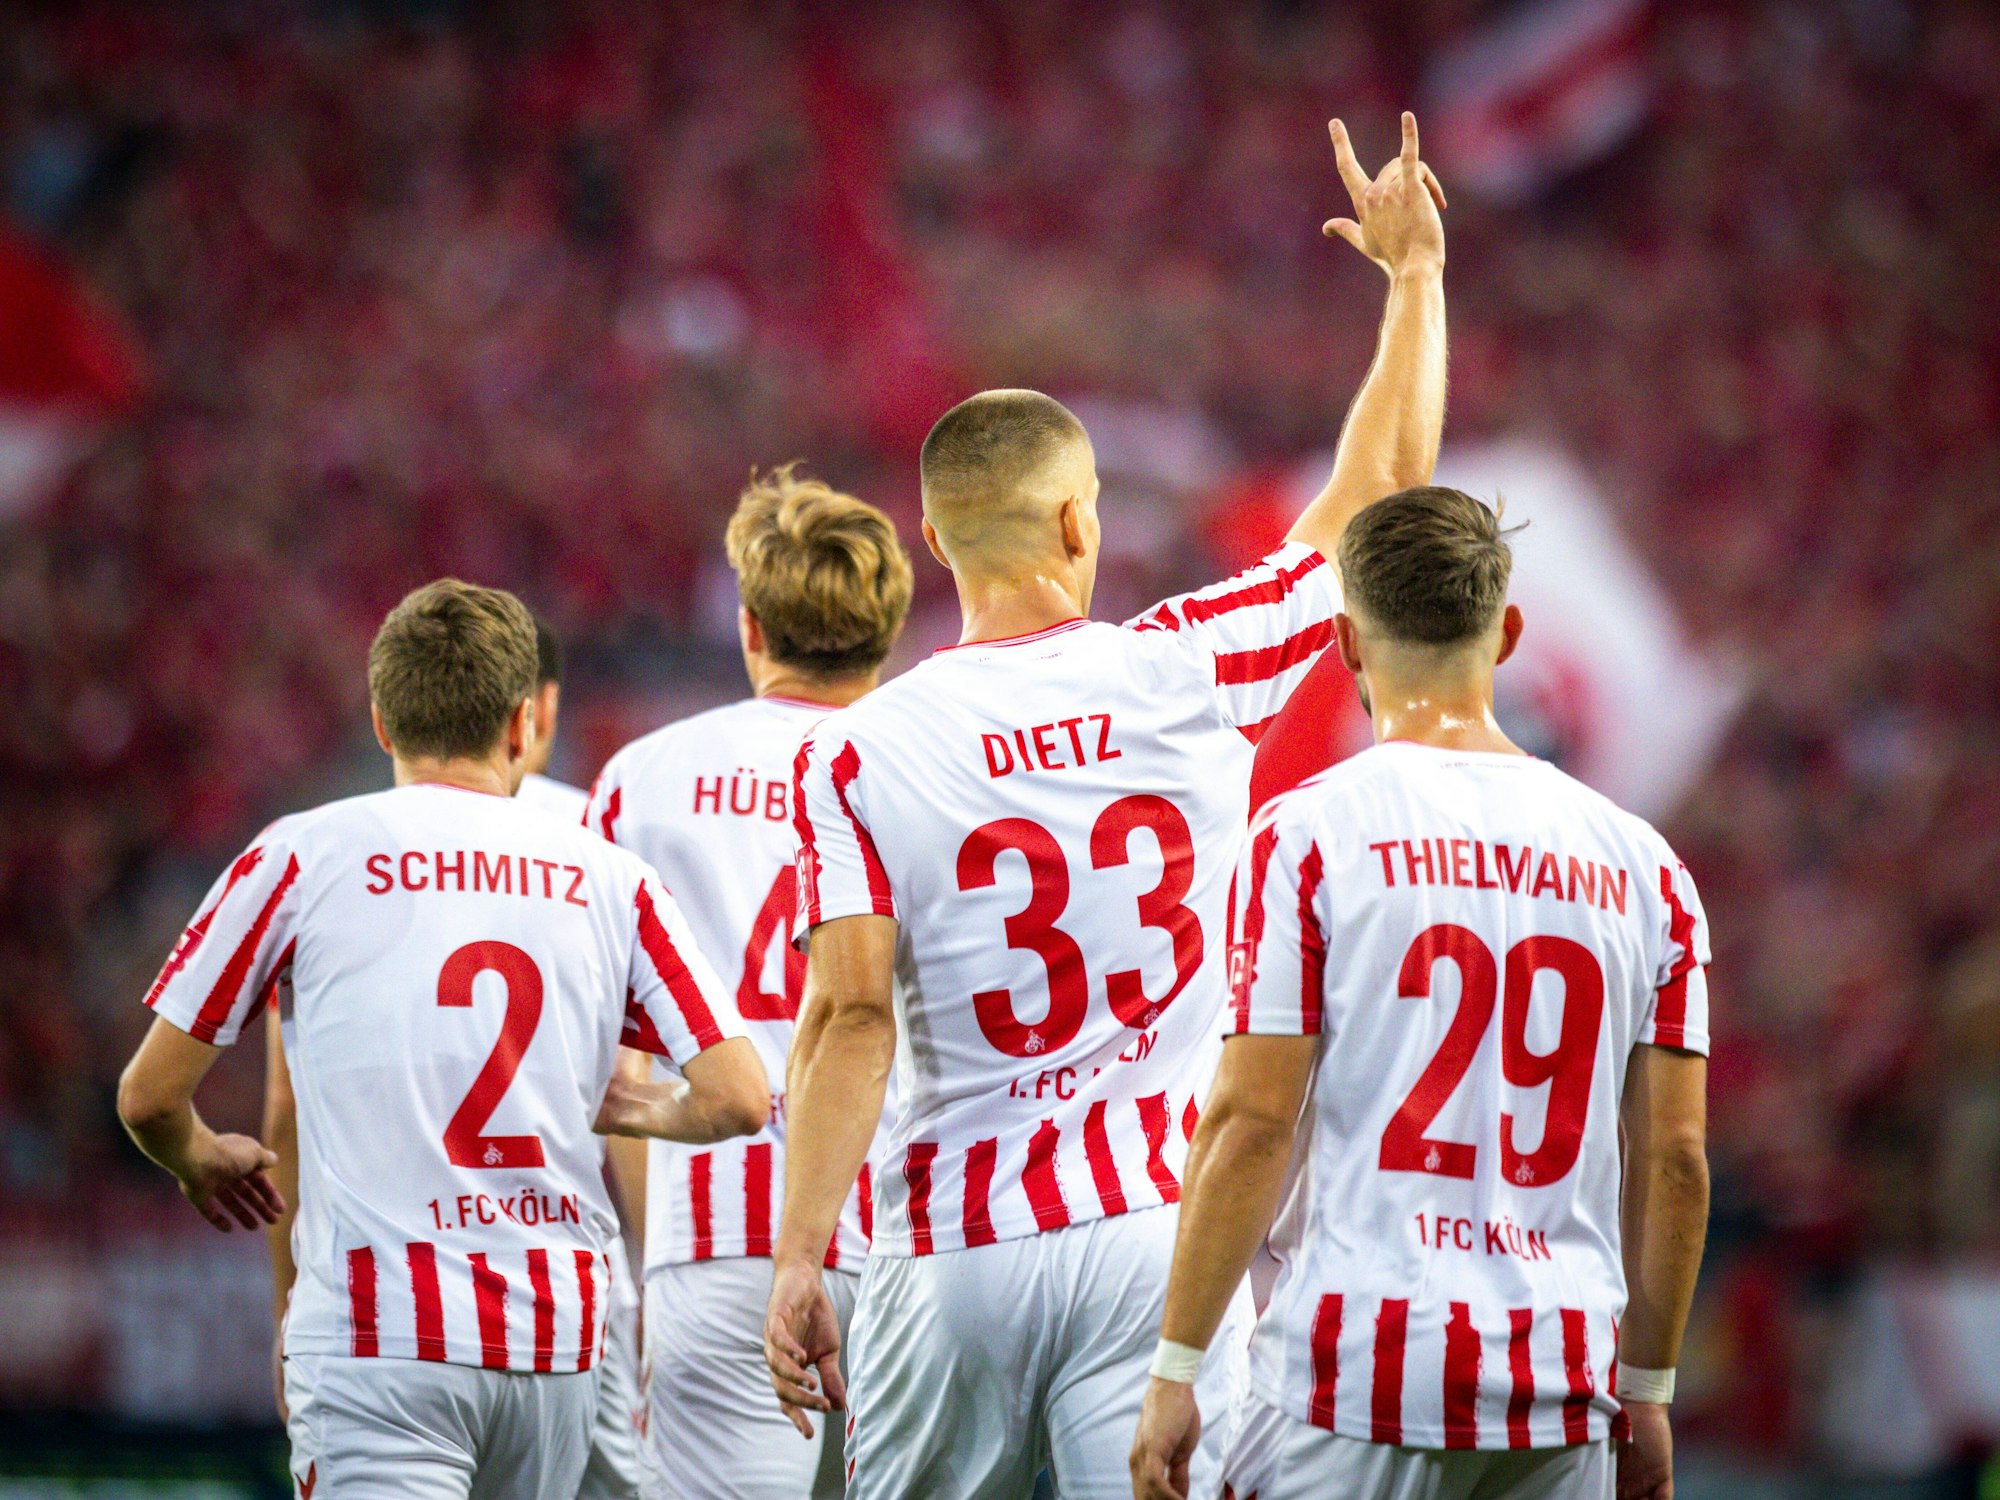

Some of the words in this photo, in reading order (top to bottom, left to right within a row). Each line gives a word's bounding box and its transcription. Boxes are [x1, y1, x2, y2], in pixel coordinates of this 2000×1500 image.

[980, 712, 1123, 780] DIETZ
[365, 850, 590, 907] SCHMITZ
[955, 793, 1205, 1058] 33
[1368, 838, 1628, 916] THIELMANN
[736, 864, 810, 1021] 4
[436, 939, 547, 1170] 2
[1377, 922, 1605, 1189] 29
[498, 1187, 580, 1226] KÖLN
